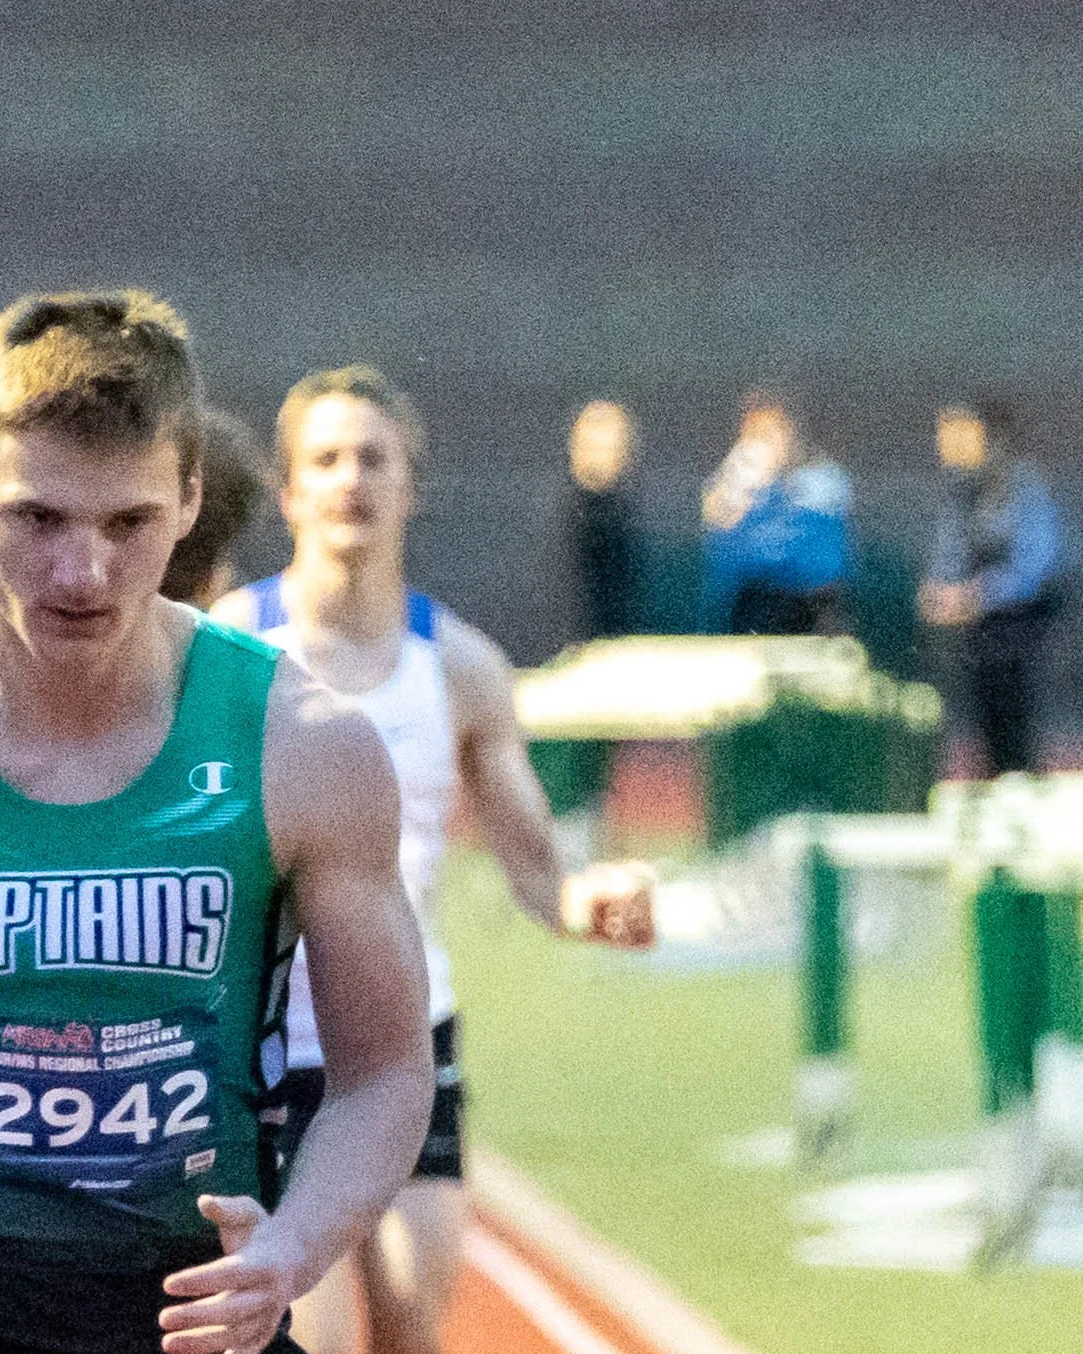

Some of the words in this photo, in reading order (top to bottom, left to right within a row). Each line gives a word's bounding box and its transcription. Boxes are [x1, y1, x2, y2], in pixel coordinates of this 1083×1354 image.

[101, 1018, 161, 1039] CROSS
[101, 1025, 183, 1052] COUNTRY
[39, 1056, 99, 1072] REGIONAL
